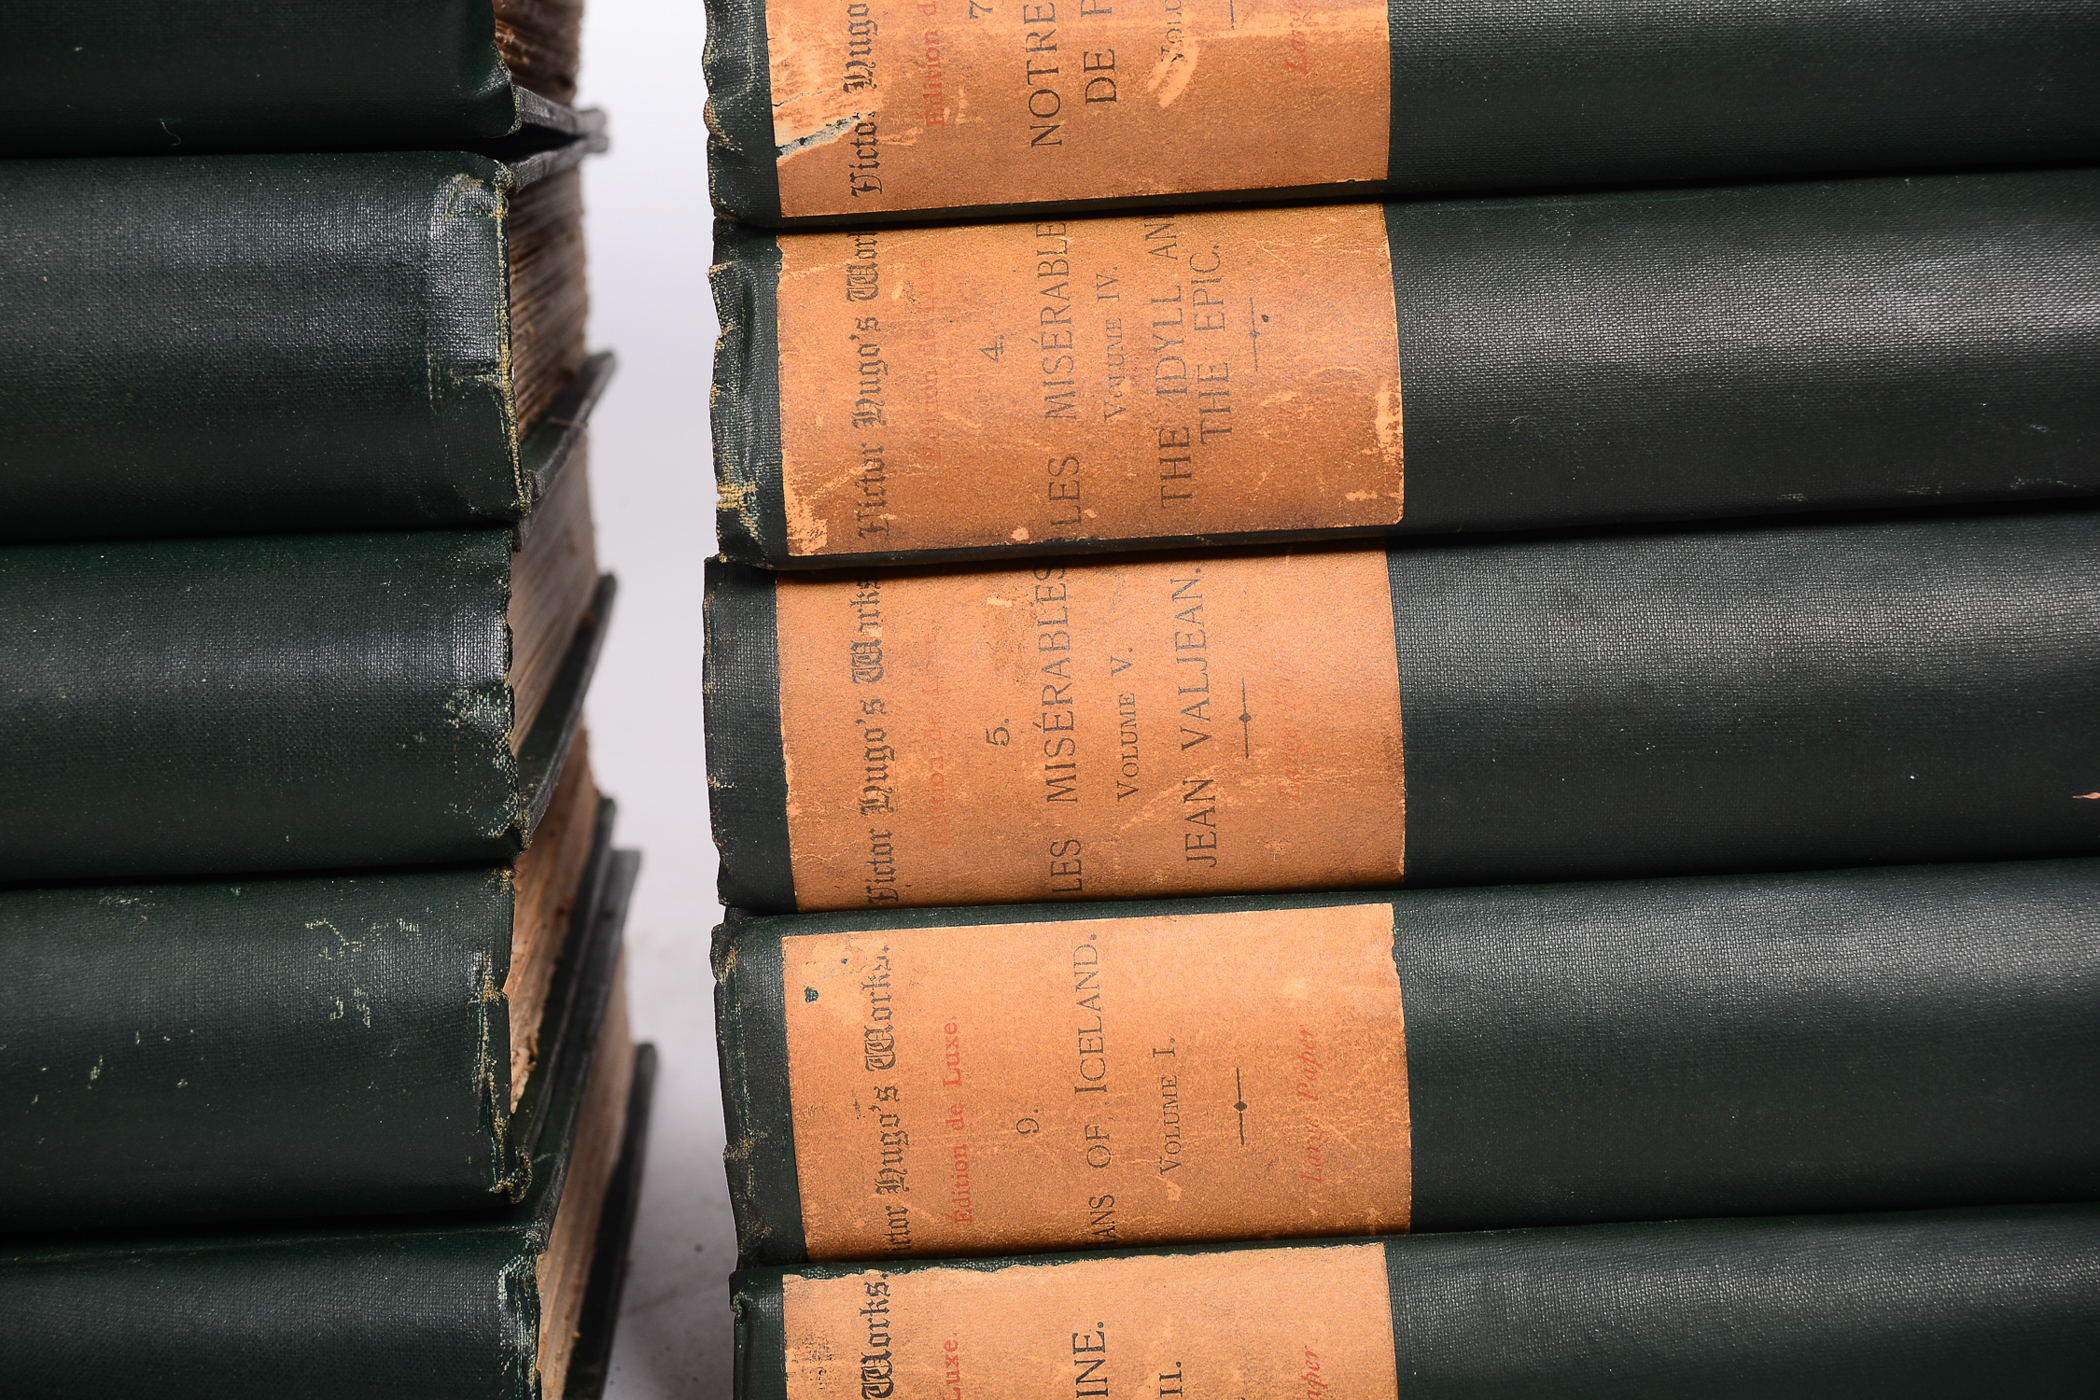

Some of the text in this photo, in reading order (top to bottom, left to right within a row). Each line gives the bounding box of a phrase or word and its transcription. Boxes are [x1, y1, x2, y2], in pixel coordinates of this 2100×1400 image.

[916, 30, 946, 128] Édition
[1082, 49, 1118, 106] DE
[1096, 265, 1120, 303] IV.
[847, 316, 889, 430] Hugo's
[979, 335, 1004, 362] 4.
[1143, 217, 1193, 509] THE IDYLL AN
[1189, 244, 1233, 445] THE EPIC.
[853, 441, 890, 540] Victor
[1046, 456, 1082, 527] LES
[1110, 648, 1134, 677] V.
[985, 718, 1010, 747] 5.
[1032, 566, 1083, 894] LES MISÉRABLES
[1170, 567, 1218, 869] JEAN VALJEAN.
[856, 699, 895, 815] Hugo's
[864, 828, 899, 904] Victor
[1152, 1037, 1177, 1058] I.
[867, 1085, 910, 1196] Hugo's
[941, 1015, 974, 1224] Édition de Luxe.
[1016, 1108, 1040, 1135] 9.
[1084, 1124, 1112, 1170] OF
[1300, 1115, 1328, 1185] Large
[1087, 1194, 1116, 1244] ANS
